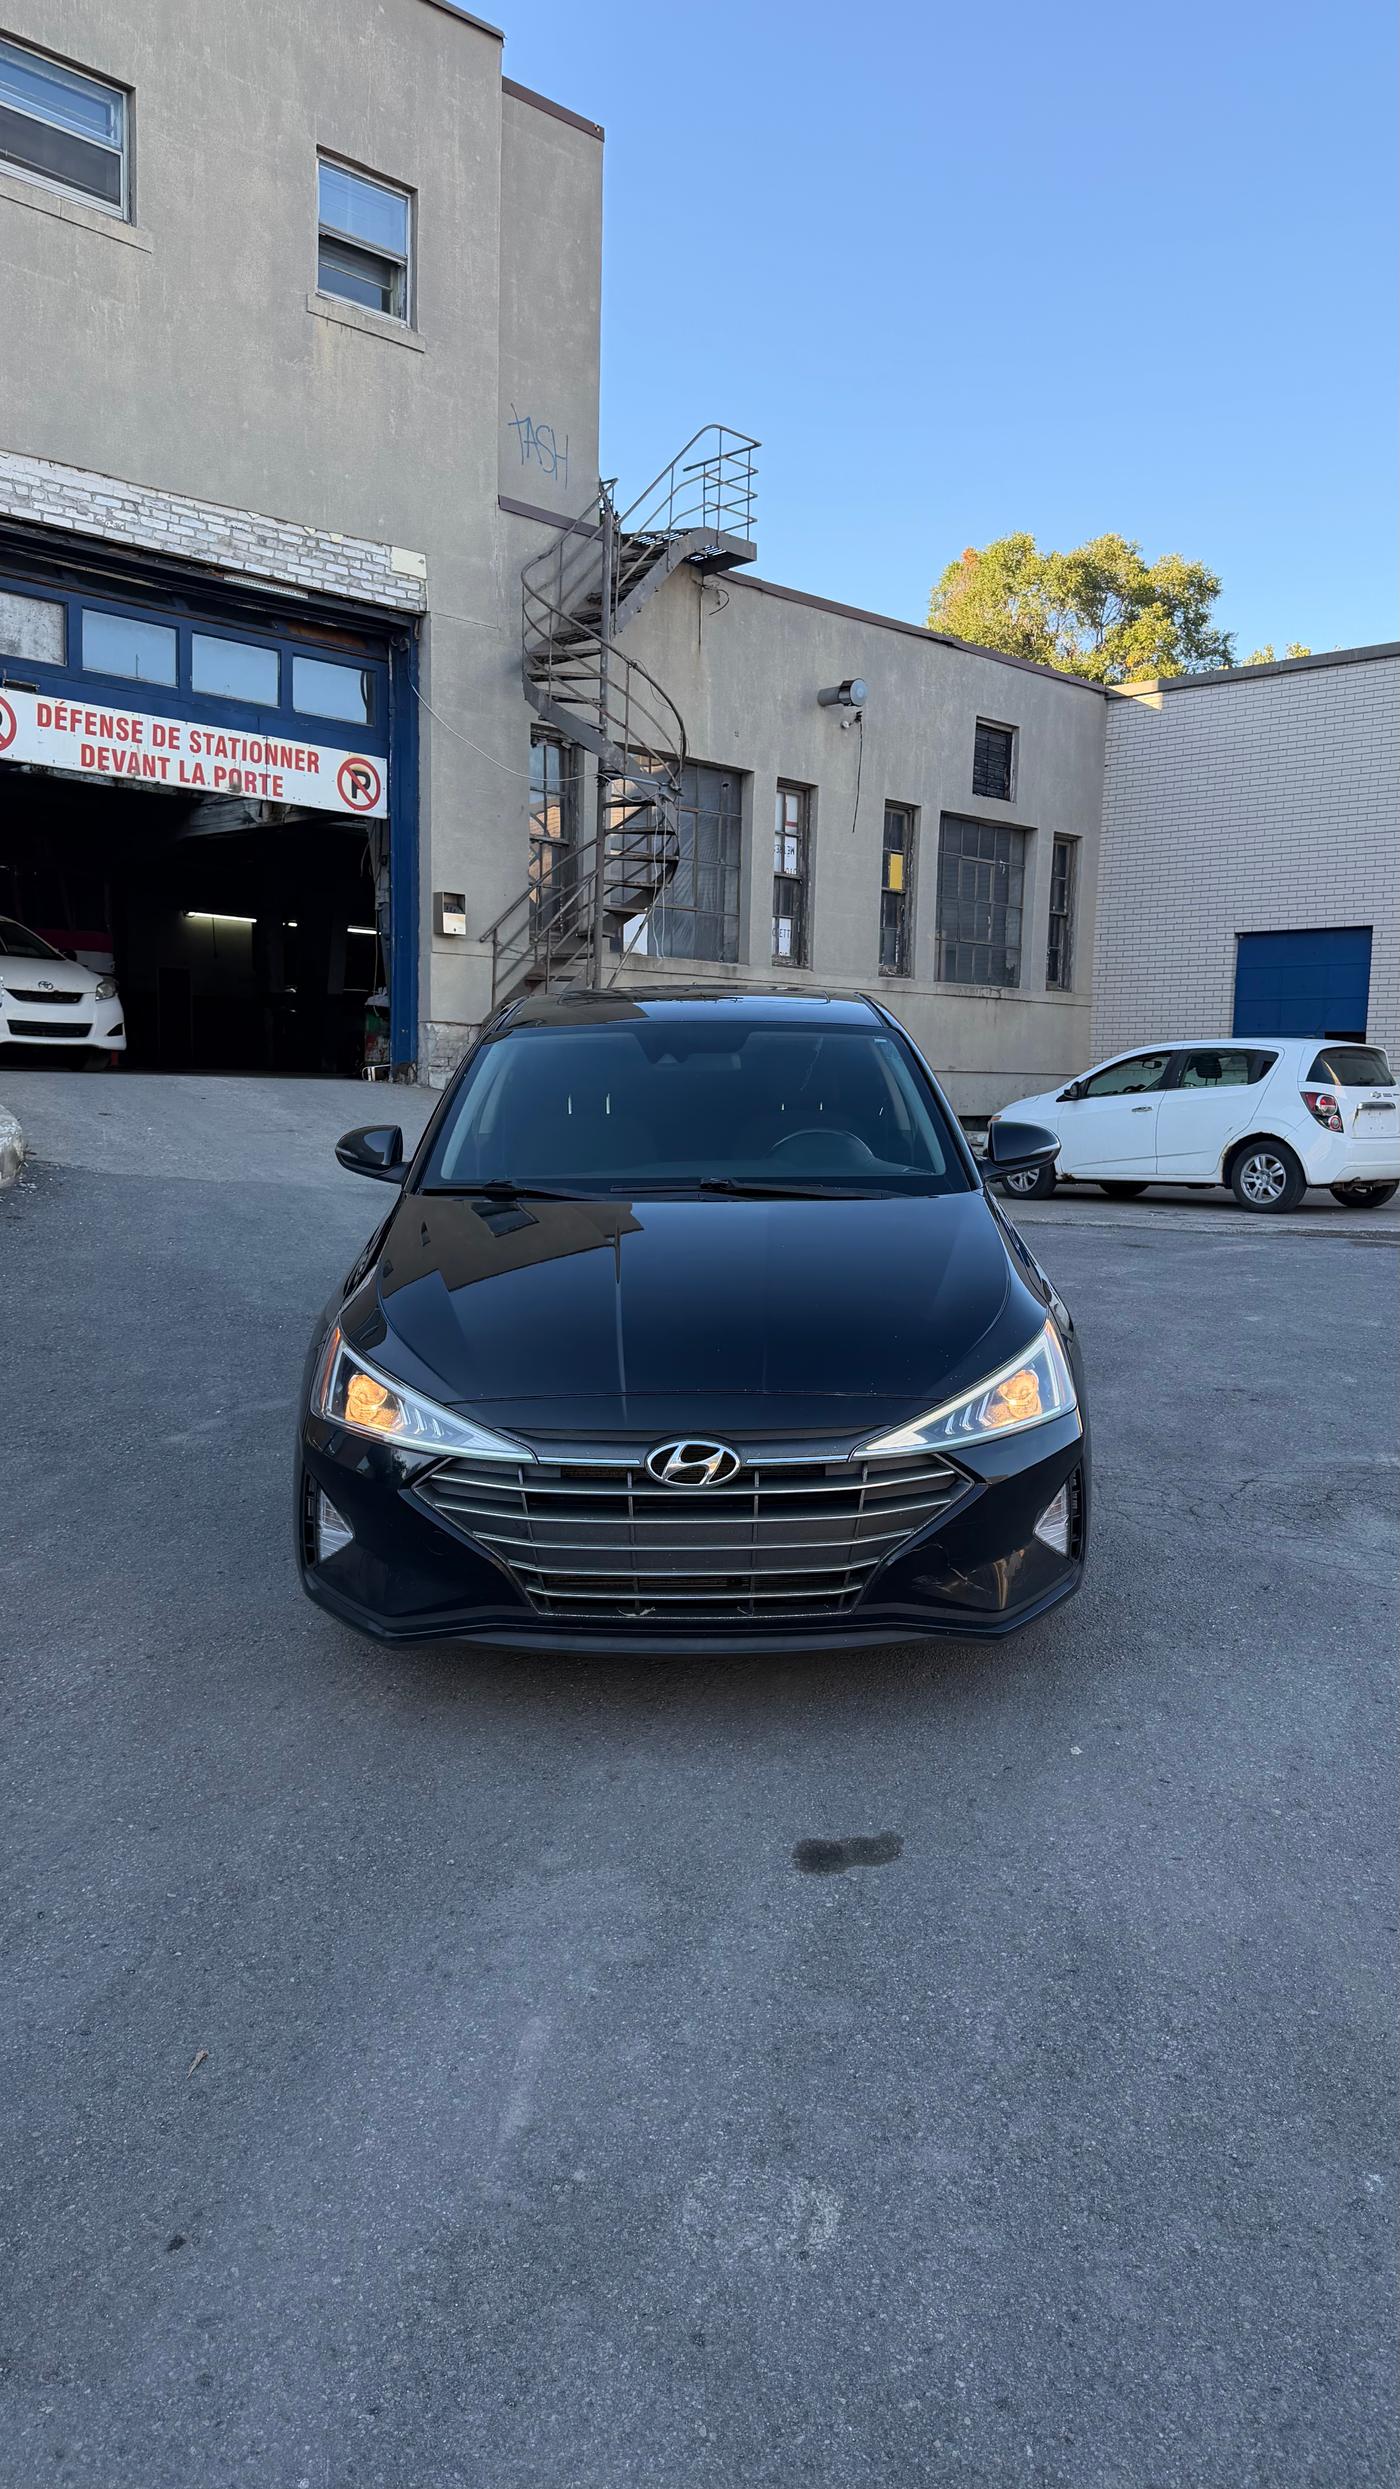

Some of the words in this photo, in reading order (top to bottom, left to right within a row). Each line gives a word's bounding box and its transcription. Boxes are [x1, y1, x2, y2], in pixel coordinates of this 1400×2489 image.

[508, 403, 568, 489] TASH
[37, 701, 143, 744] DÉFENSE
[153, 724, 181, 751] DE
[189, 730, 320, 774] STATIONNER
[81, 744, 171, 780] DEVANT
[179, 760, 206, 786] LA
[214, 765, 284, 798] PORTE
